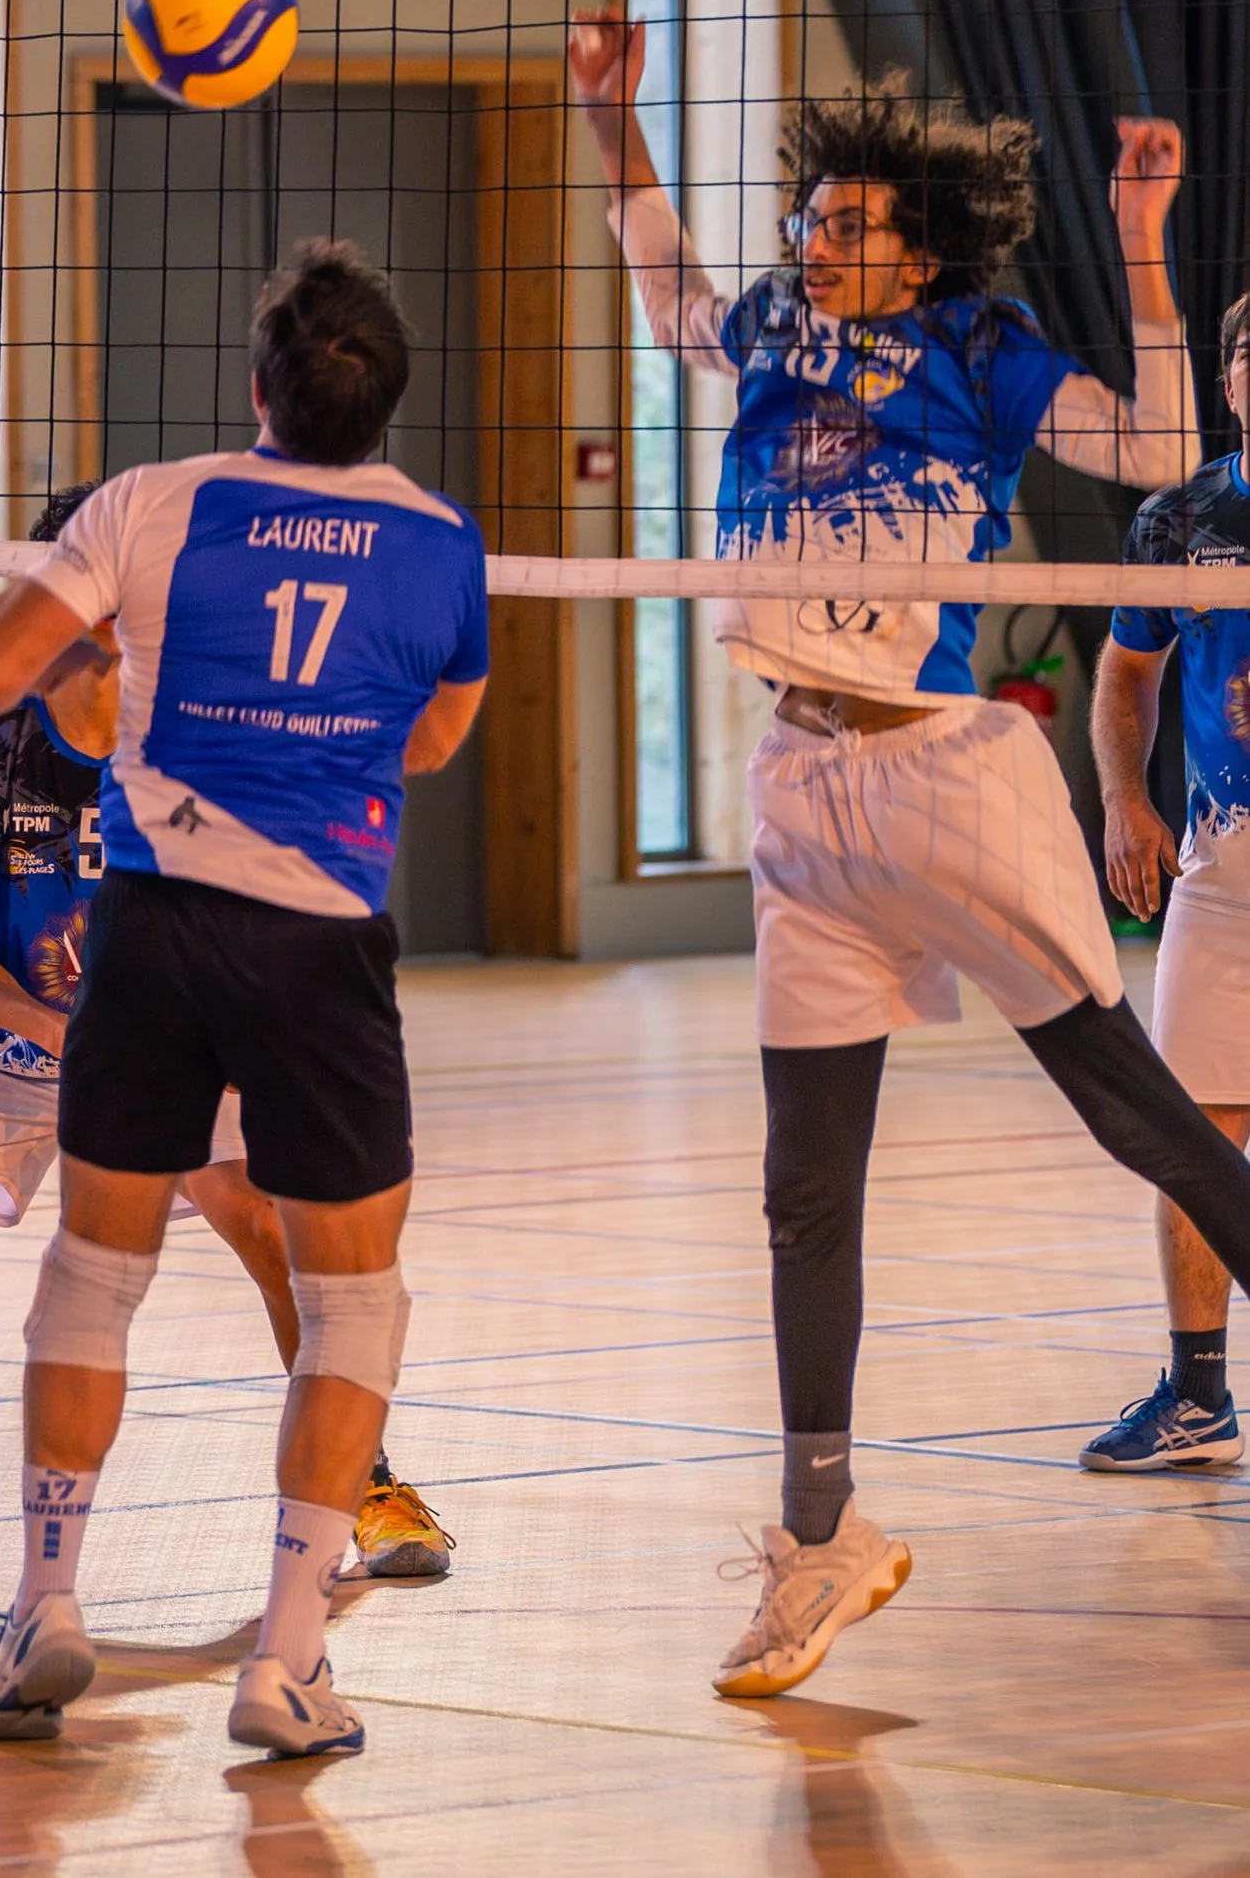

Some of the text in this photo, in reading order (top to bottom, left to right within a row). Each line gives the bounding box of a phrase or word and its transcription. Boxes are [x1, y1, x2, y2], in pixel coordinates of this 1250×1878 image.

[248, 516, 380, 559] LAURENT
[264, 578, 349, 686] 17
[13, 803, 60, 814] Métropole
[12, 816, 51, 833] TPM
[37, 1479, 77, 1501] 17
